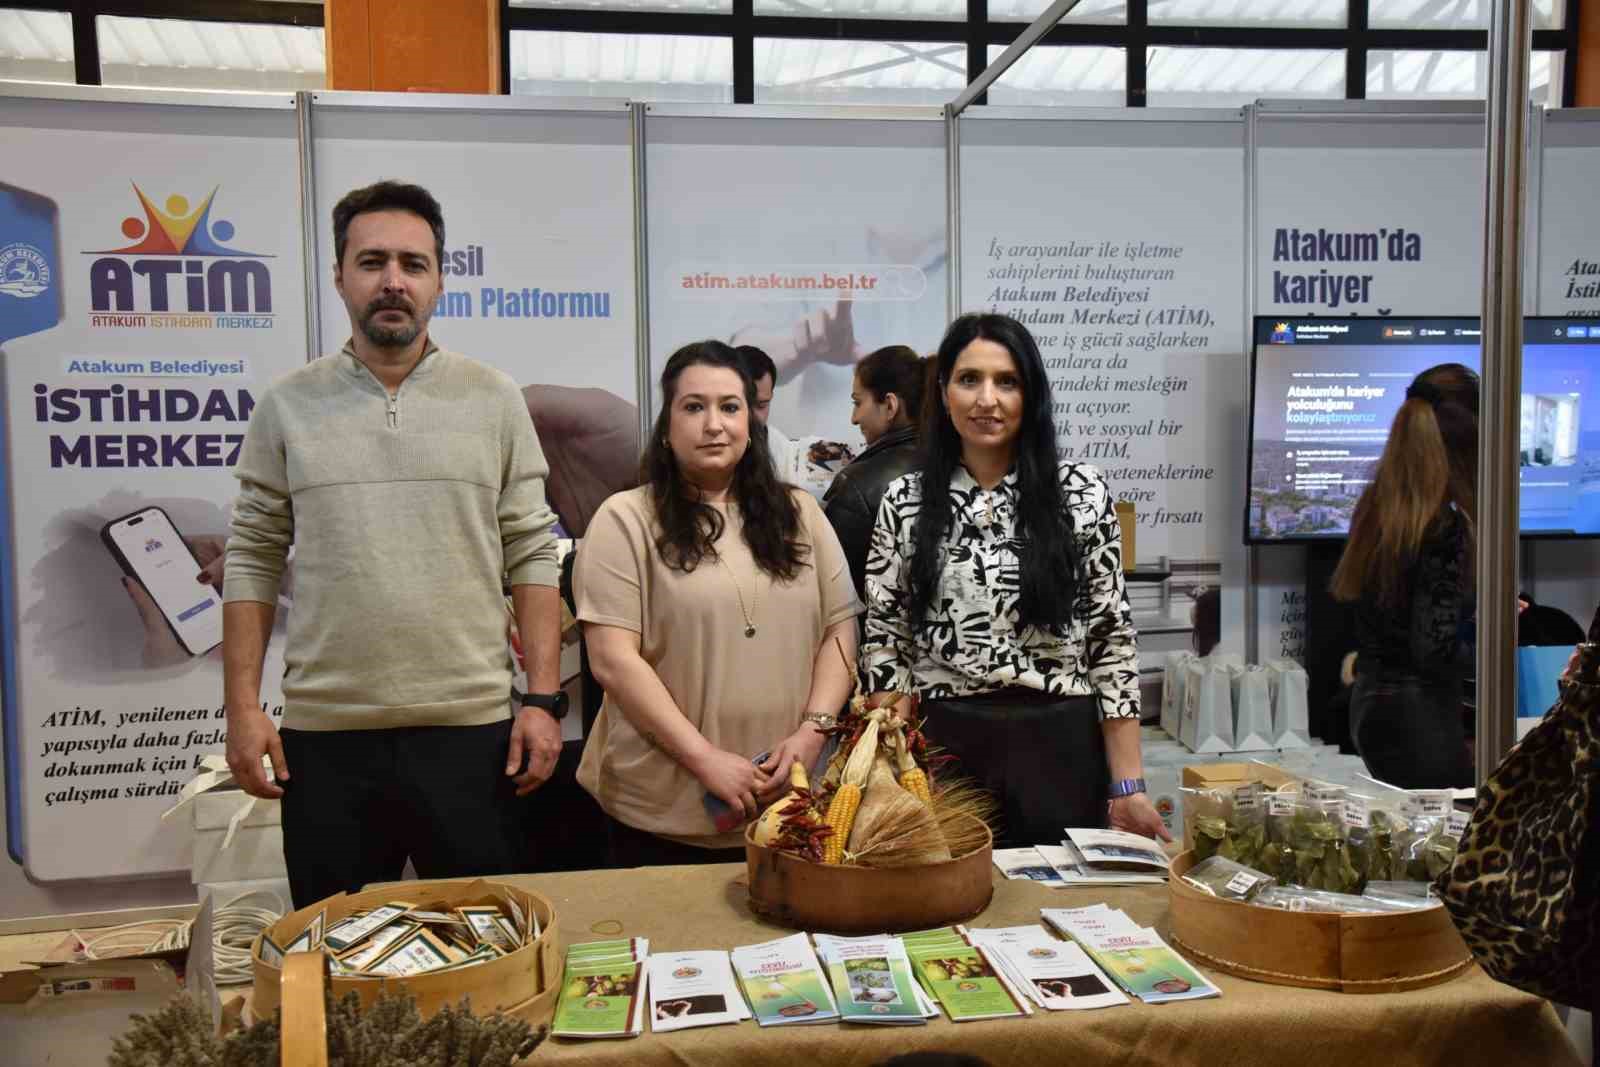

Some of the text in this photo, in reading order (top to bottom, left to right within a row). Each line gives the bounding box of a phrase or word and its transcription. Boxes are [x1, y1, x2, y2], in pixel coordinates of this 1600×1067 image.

[987, 236, 1184, 262] İş arayanlar ile işletme
[1273, 228, 1421, 262] Atakum'da
[987, 263, 1175, 283] sahiplerini buluşturan
[1564, 258, 1600, 276] Ata
[681, 271, 877, 290] atim.atakum.bel.tr
[1273, 269, 1373, 307] kariyer
[480, 287, 611, 318] Platformu
[987, 286, 1151, 306] Atakum Belediyesi
[92, 316, 146, 329] ATAKUM
[1069, 308, 1141, 326] Merkezi
[1145, 304, 1215, 328] (ATİM),
[1063, 330, 1077, 350] iş
[1081, 331, 1123, 351] gücü
[1125, 331, 1209, 351] sağlarken
[68, 360, 244, 377] Atakum Belediyesi
[1106, 353, 1128, 369] da
[1114, 376, 1188, 396] mesleğin
[1346, 385, 1386, 400] kariyer
[1075, 402, 1131, 418] açıyor.
[1078, 424, 1096, 436] ve
[1100, 421, 1152, 440] sosyal
[1158, 420, 1183, 436] bir
[1078, 438, 1131, 460] ATİM,
[1104, 464, 1215, 481] yeteneklerine
[1150, 507, 1204, 528] fırsatı
[40, 705, 107, 728] ATİM,
[116, 705, 209, 728] yenilenen
[40, 734, 127, 757] yapısıyla
[133, 731, 180, 748] daha
[43, 757, 147, 779] dokunmak
[152, 755, 187, 774] için
[44, 786, 119, 807] çalışma
